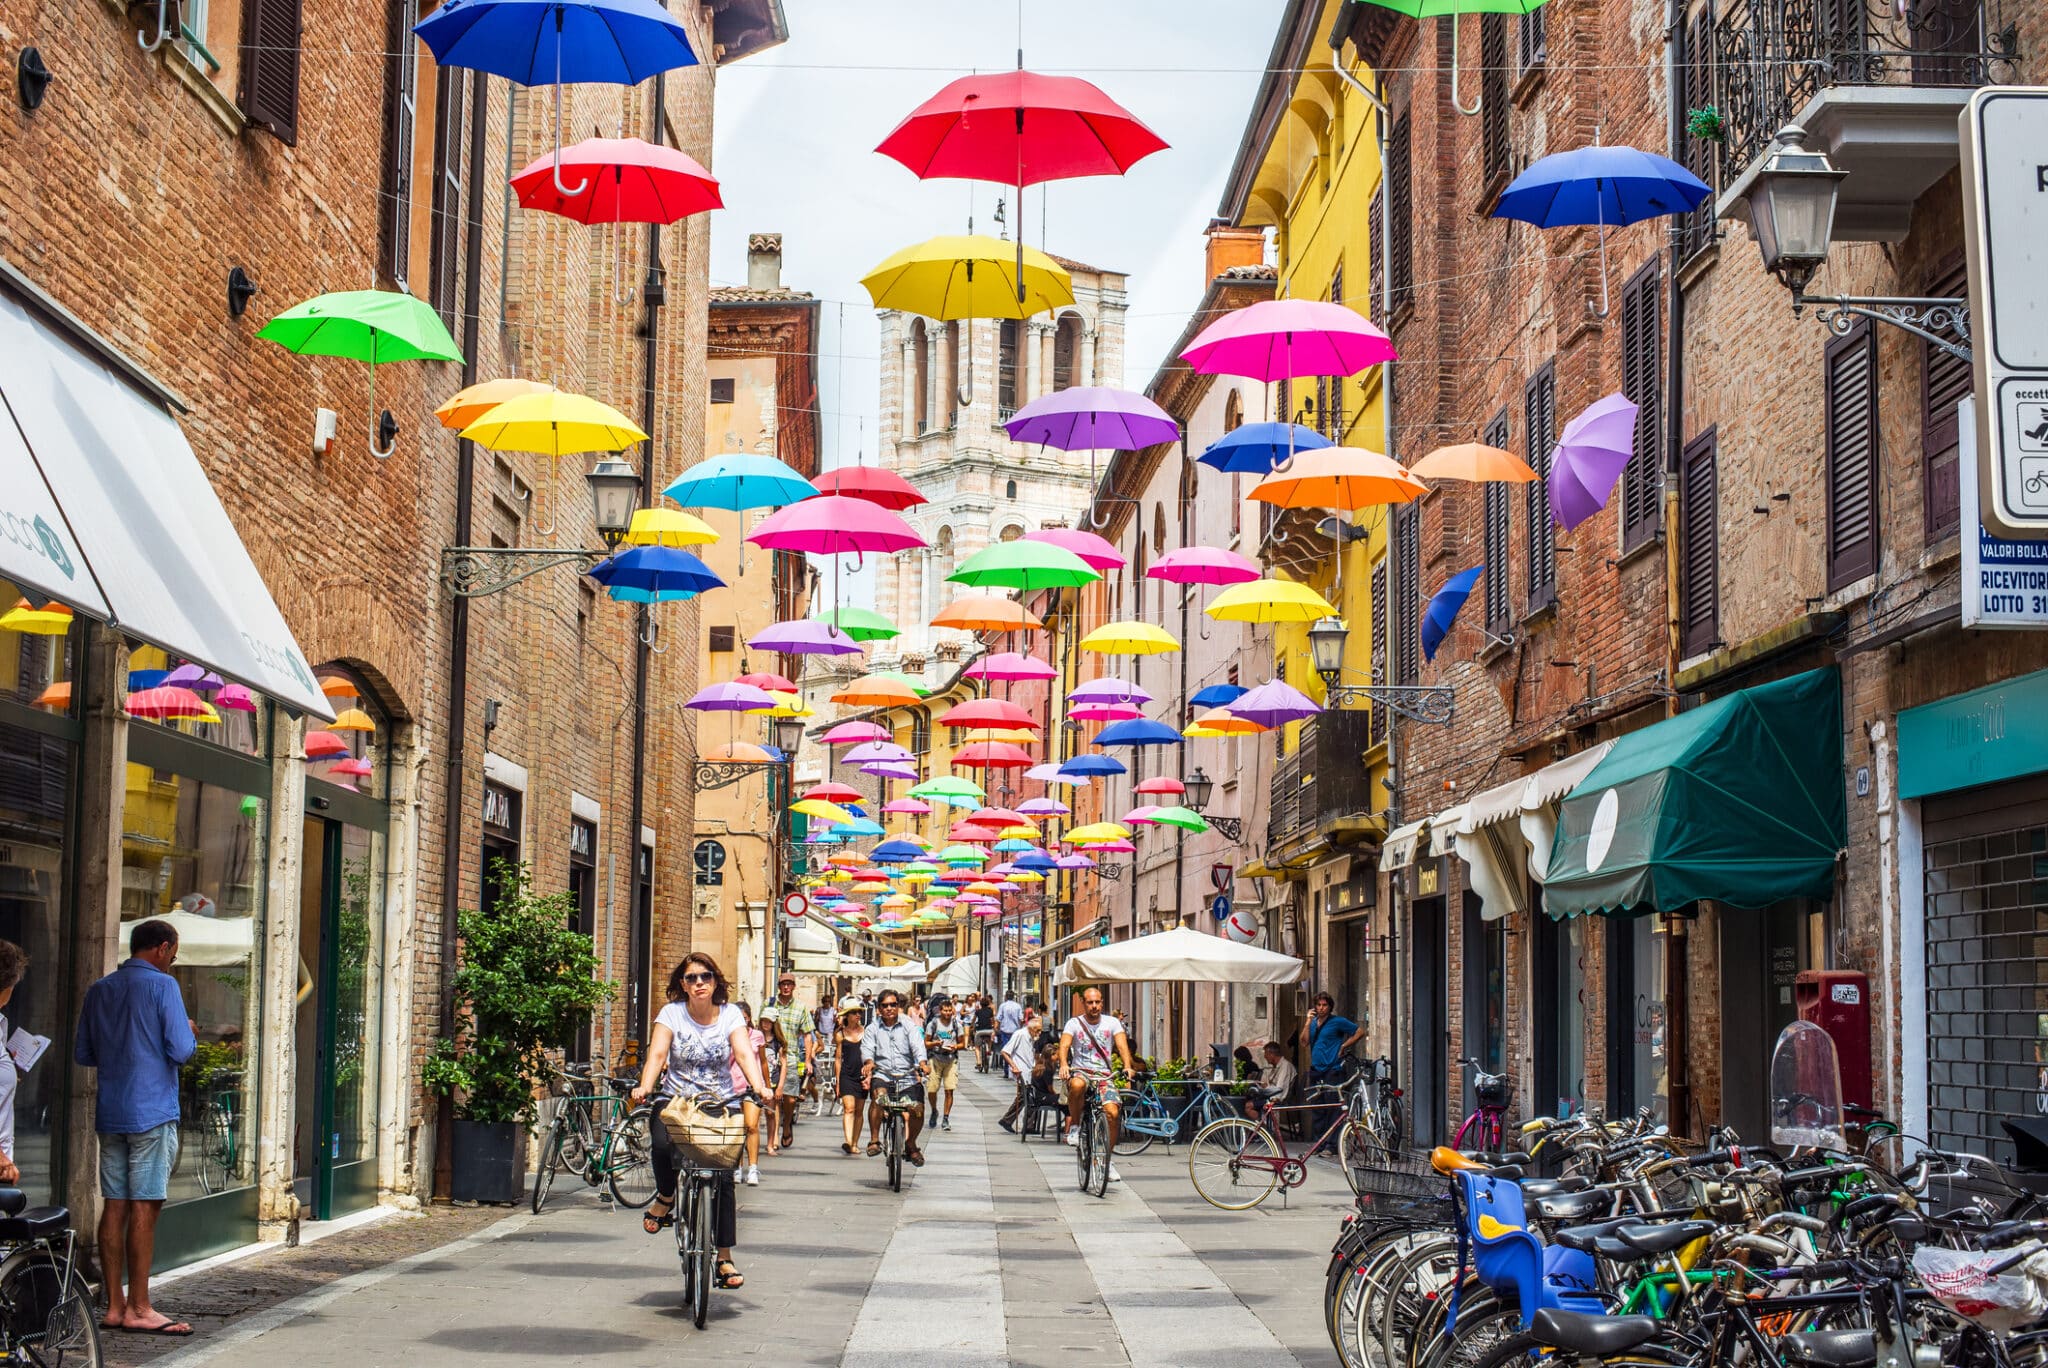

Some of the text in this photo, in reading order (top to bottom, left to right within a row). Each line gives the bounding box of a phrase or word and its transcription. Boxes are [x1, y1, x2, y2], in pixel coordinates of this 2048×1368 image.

[1981, 543, 2048, 558] VALORI BOLLA
[1981, 571, 2048, 589] RICEVITOR
[1984, 594, 2024, 613] LOTTO
[1857, 771, 1868, 792] 69
[484, 789, 510, 829] ZARA
[571, 823, 589, 855] ZARA
